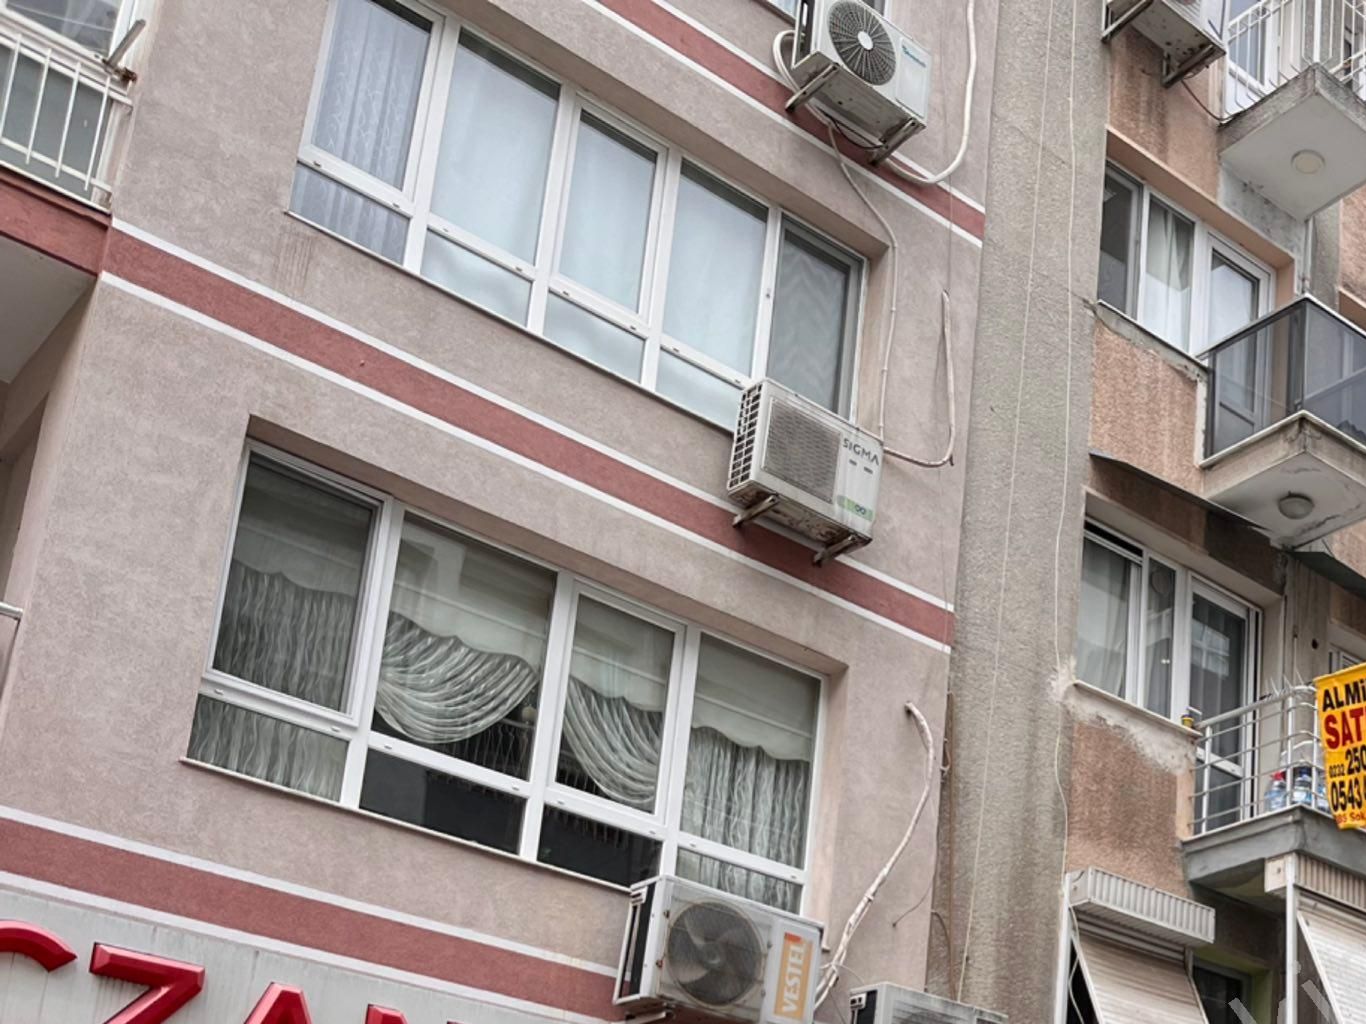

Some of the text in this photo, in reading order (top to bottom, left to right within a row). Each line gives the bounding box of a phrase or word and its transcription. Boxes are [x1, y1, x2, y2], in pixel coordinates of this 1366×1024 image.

[843, 437, 879, 466] SIGMA
[1330, 777, 1363, 812] 0543
[784, 938, 808, 1014] VESTEL
